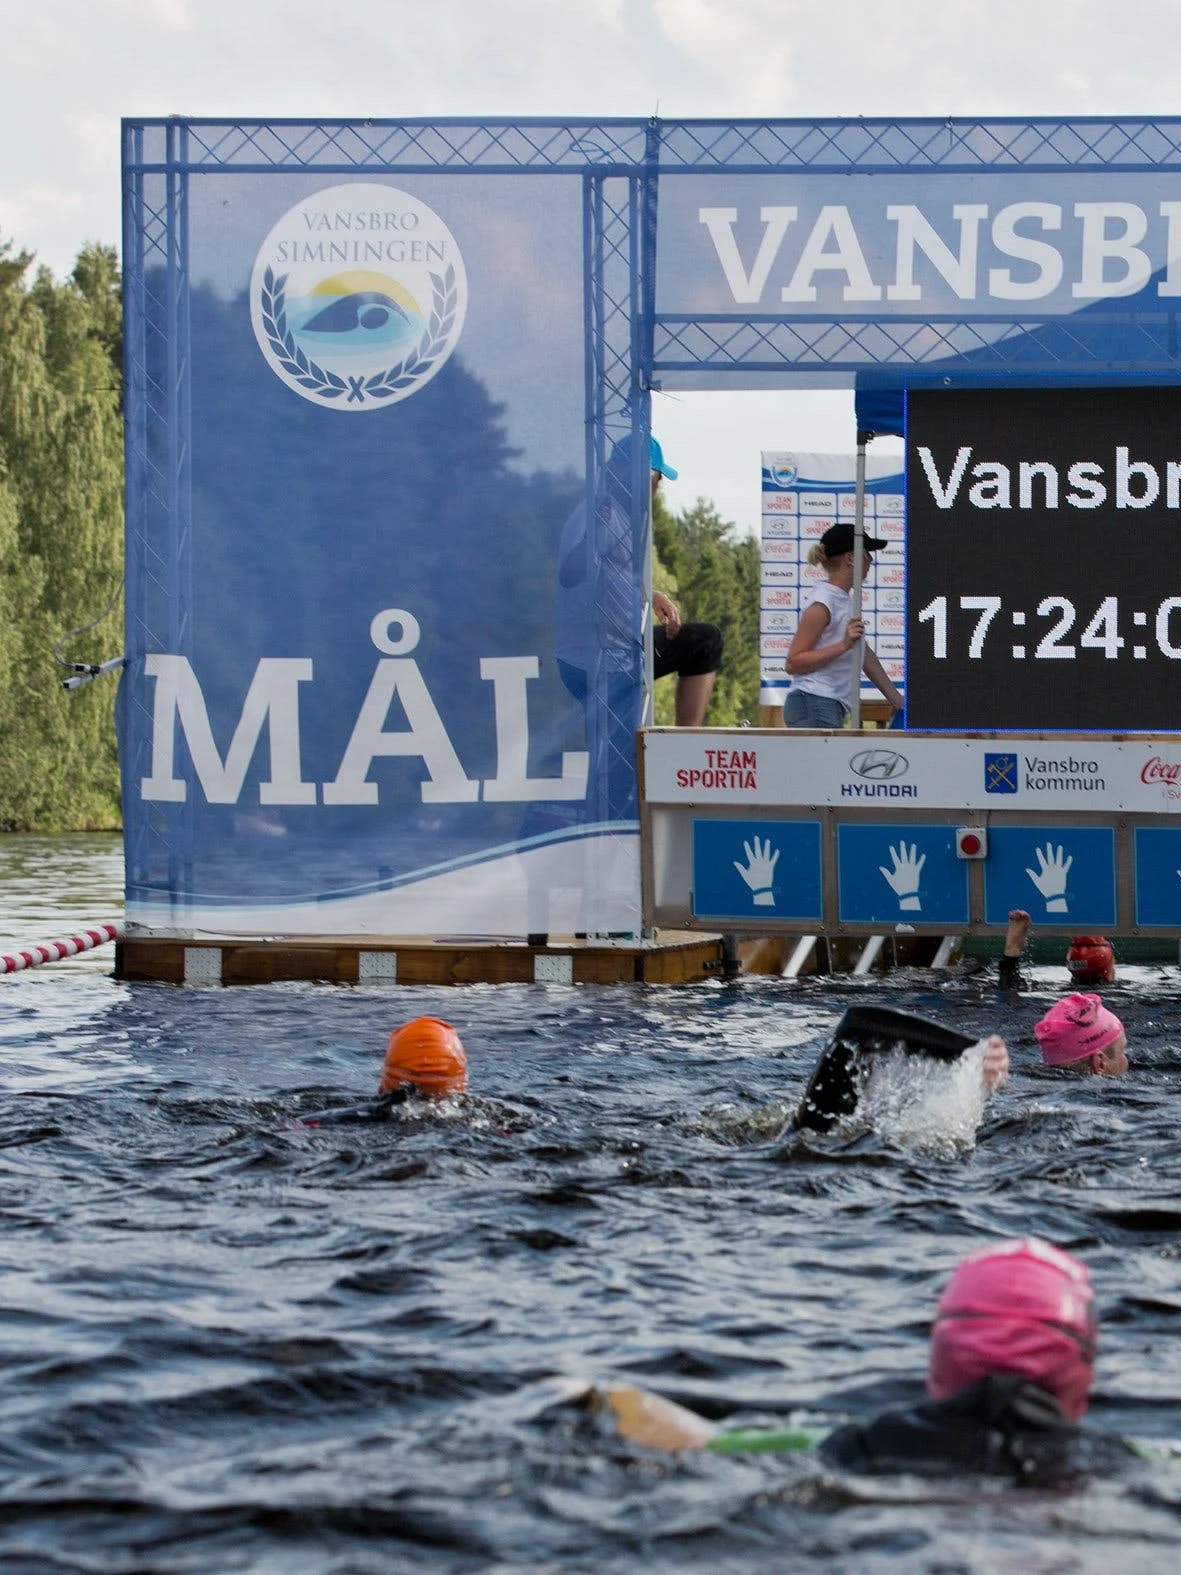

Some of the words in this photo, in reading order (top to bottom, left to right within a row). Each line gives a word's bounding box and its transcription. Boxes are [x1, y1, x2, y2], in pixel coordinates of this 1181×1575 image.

[302, 211, 420, 232] VANSBRO
[276, 239, 449, 263] SIMNINGEN
[140, 608, 590, 805] MÅL
[704, 750, 757, 769] TEAM
[1024, 756, 1099, 774] Vansbro
[676, 769, 758, 789] SPORTIA
[1025, 774, 1105, 791] kommun
[841, 784, 918, 798] HYUNDAI
